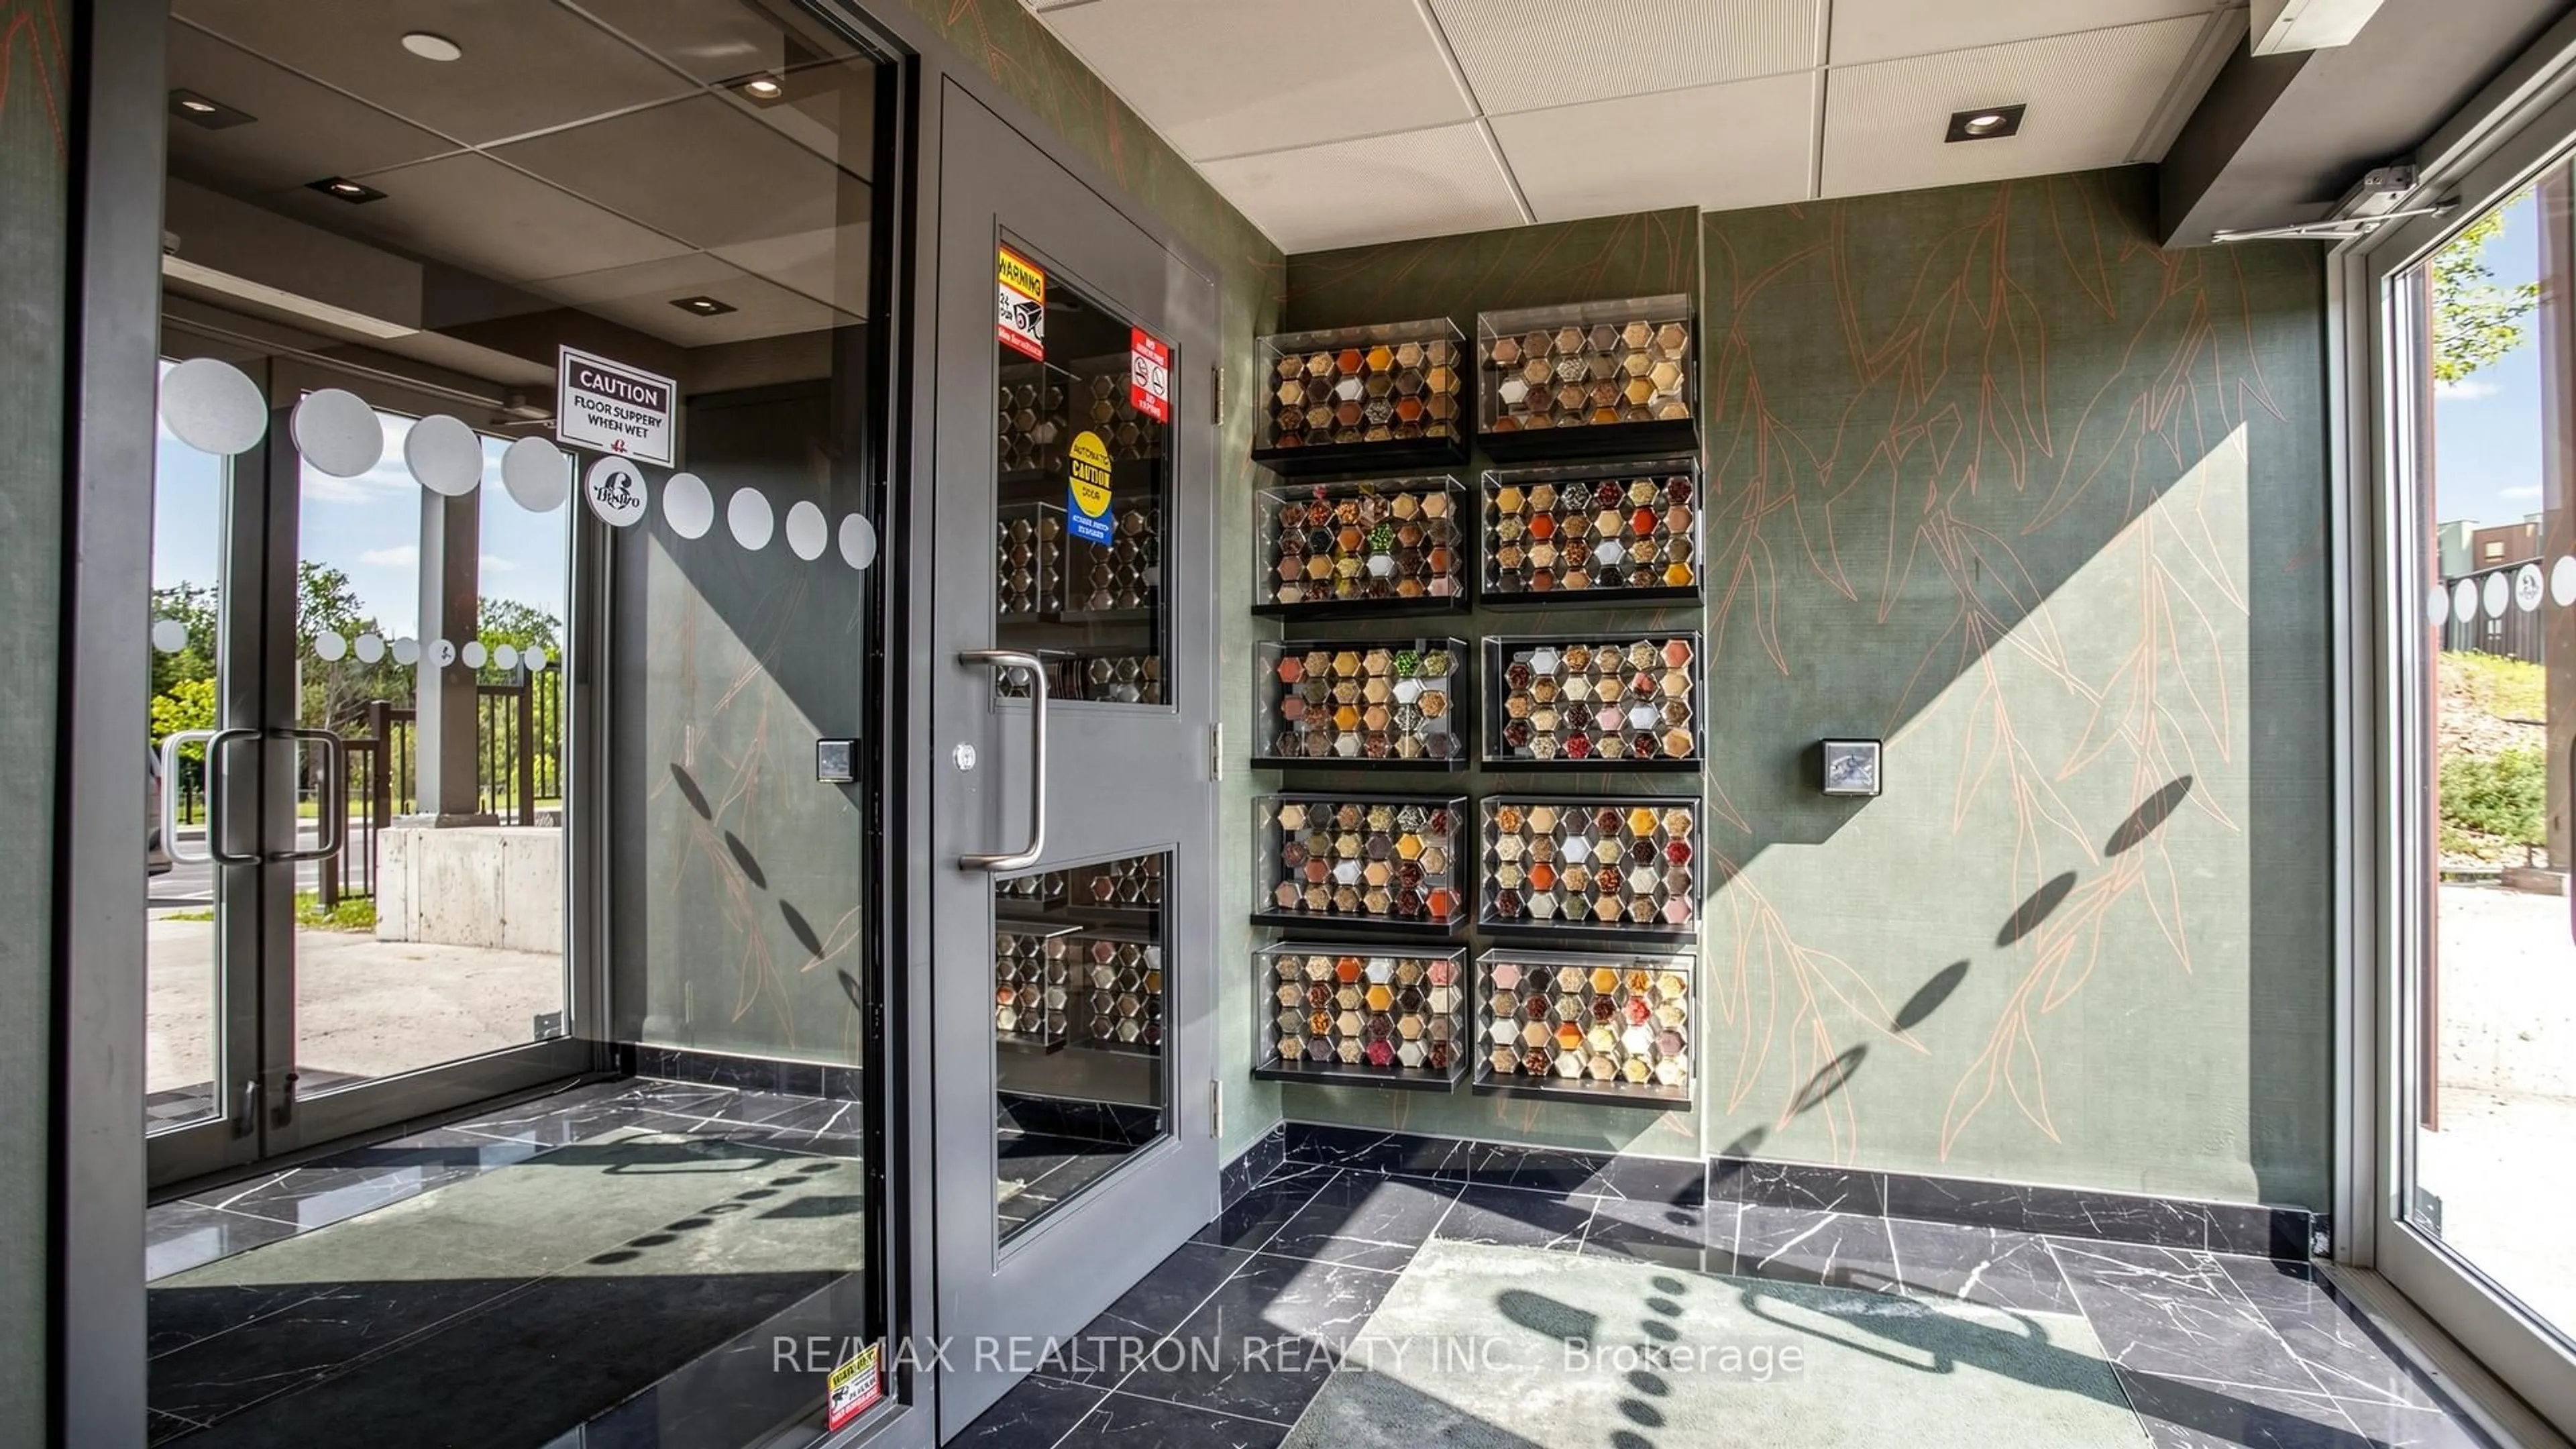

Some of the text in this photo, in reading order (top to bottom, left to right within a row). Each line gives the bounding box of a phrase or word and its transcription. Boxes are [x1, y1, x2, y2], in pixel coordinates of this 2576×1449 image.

[999, 258, 1041, 297] WARNING
[580, 370, 657, 407] CAUTION
[574, 395, 662, 428] FLOOR SLIPPERY
[588, 414, 649, 438] WHEN WET
[1073, 460, 1110, 488] CAUTION
